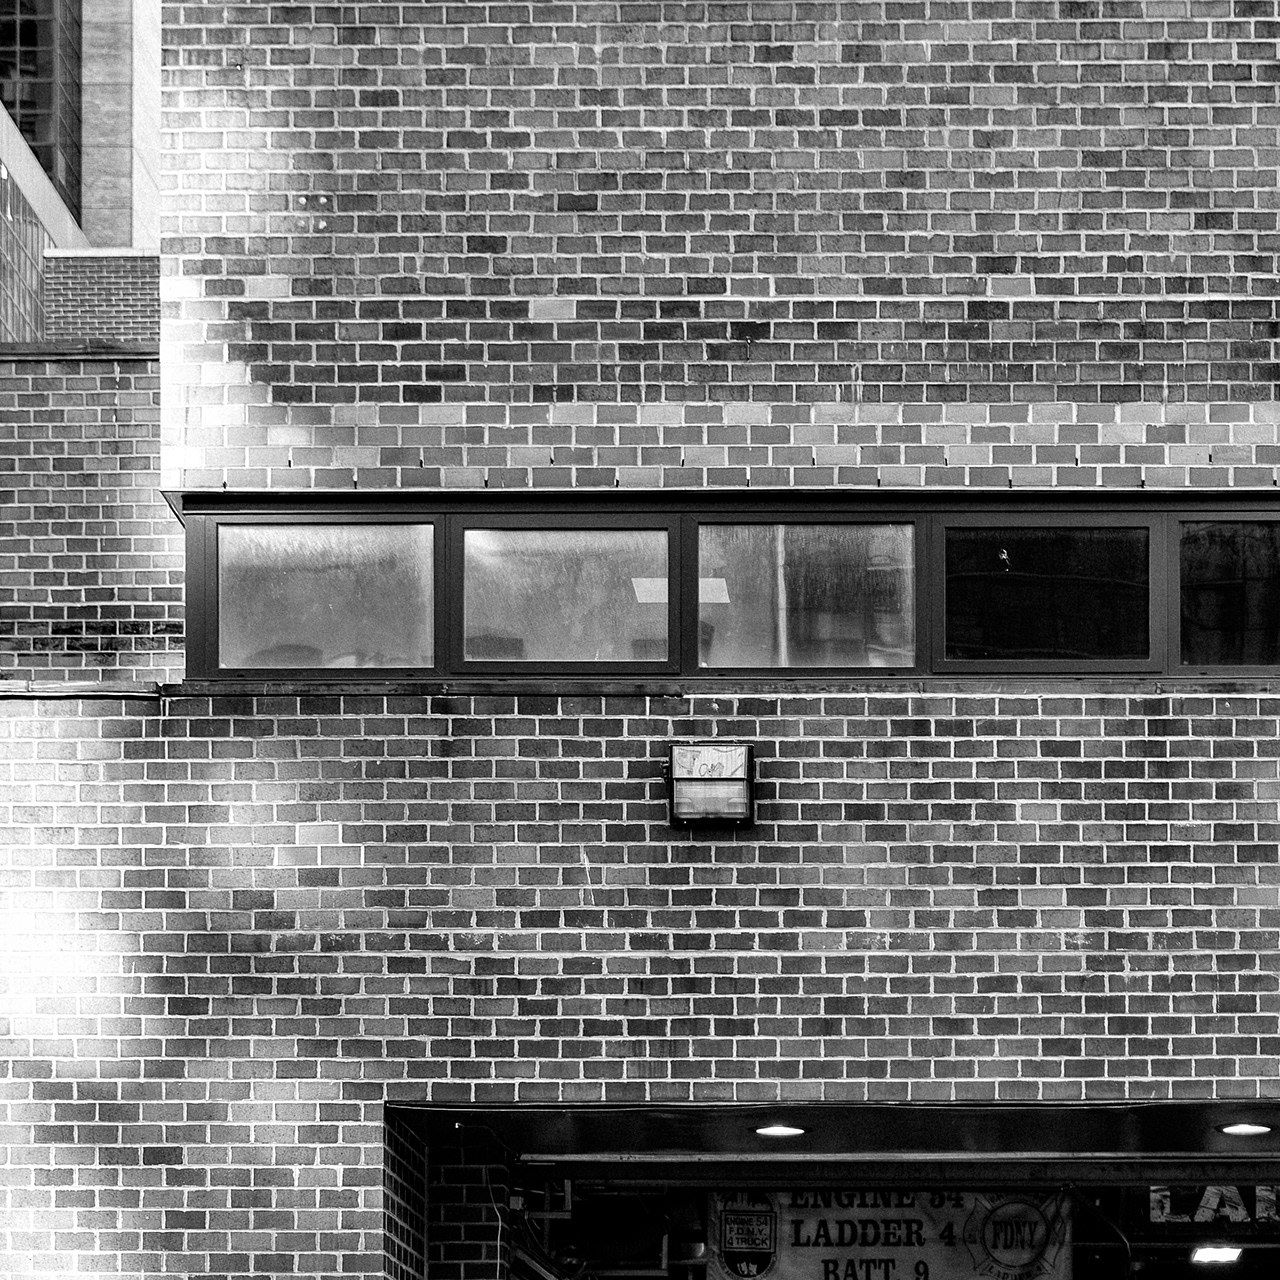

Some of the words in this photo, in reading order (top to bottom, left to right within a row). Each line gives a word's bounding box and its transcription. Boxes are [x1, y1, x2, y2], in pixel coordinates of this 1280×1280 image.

[736, 1237, 769, 1246] TRUCK
[791, 1219, 926, 1247] LADDER
[940, 1222, 957, 1247] 4
